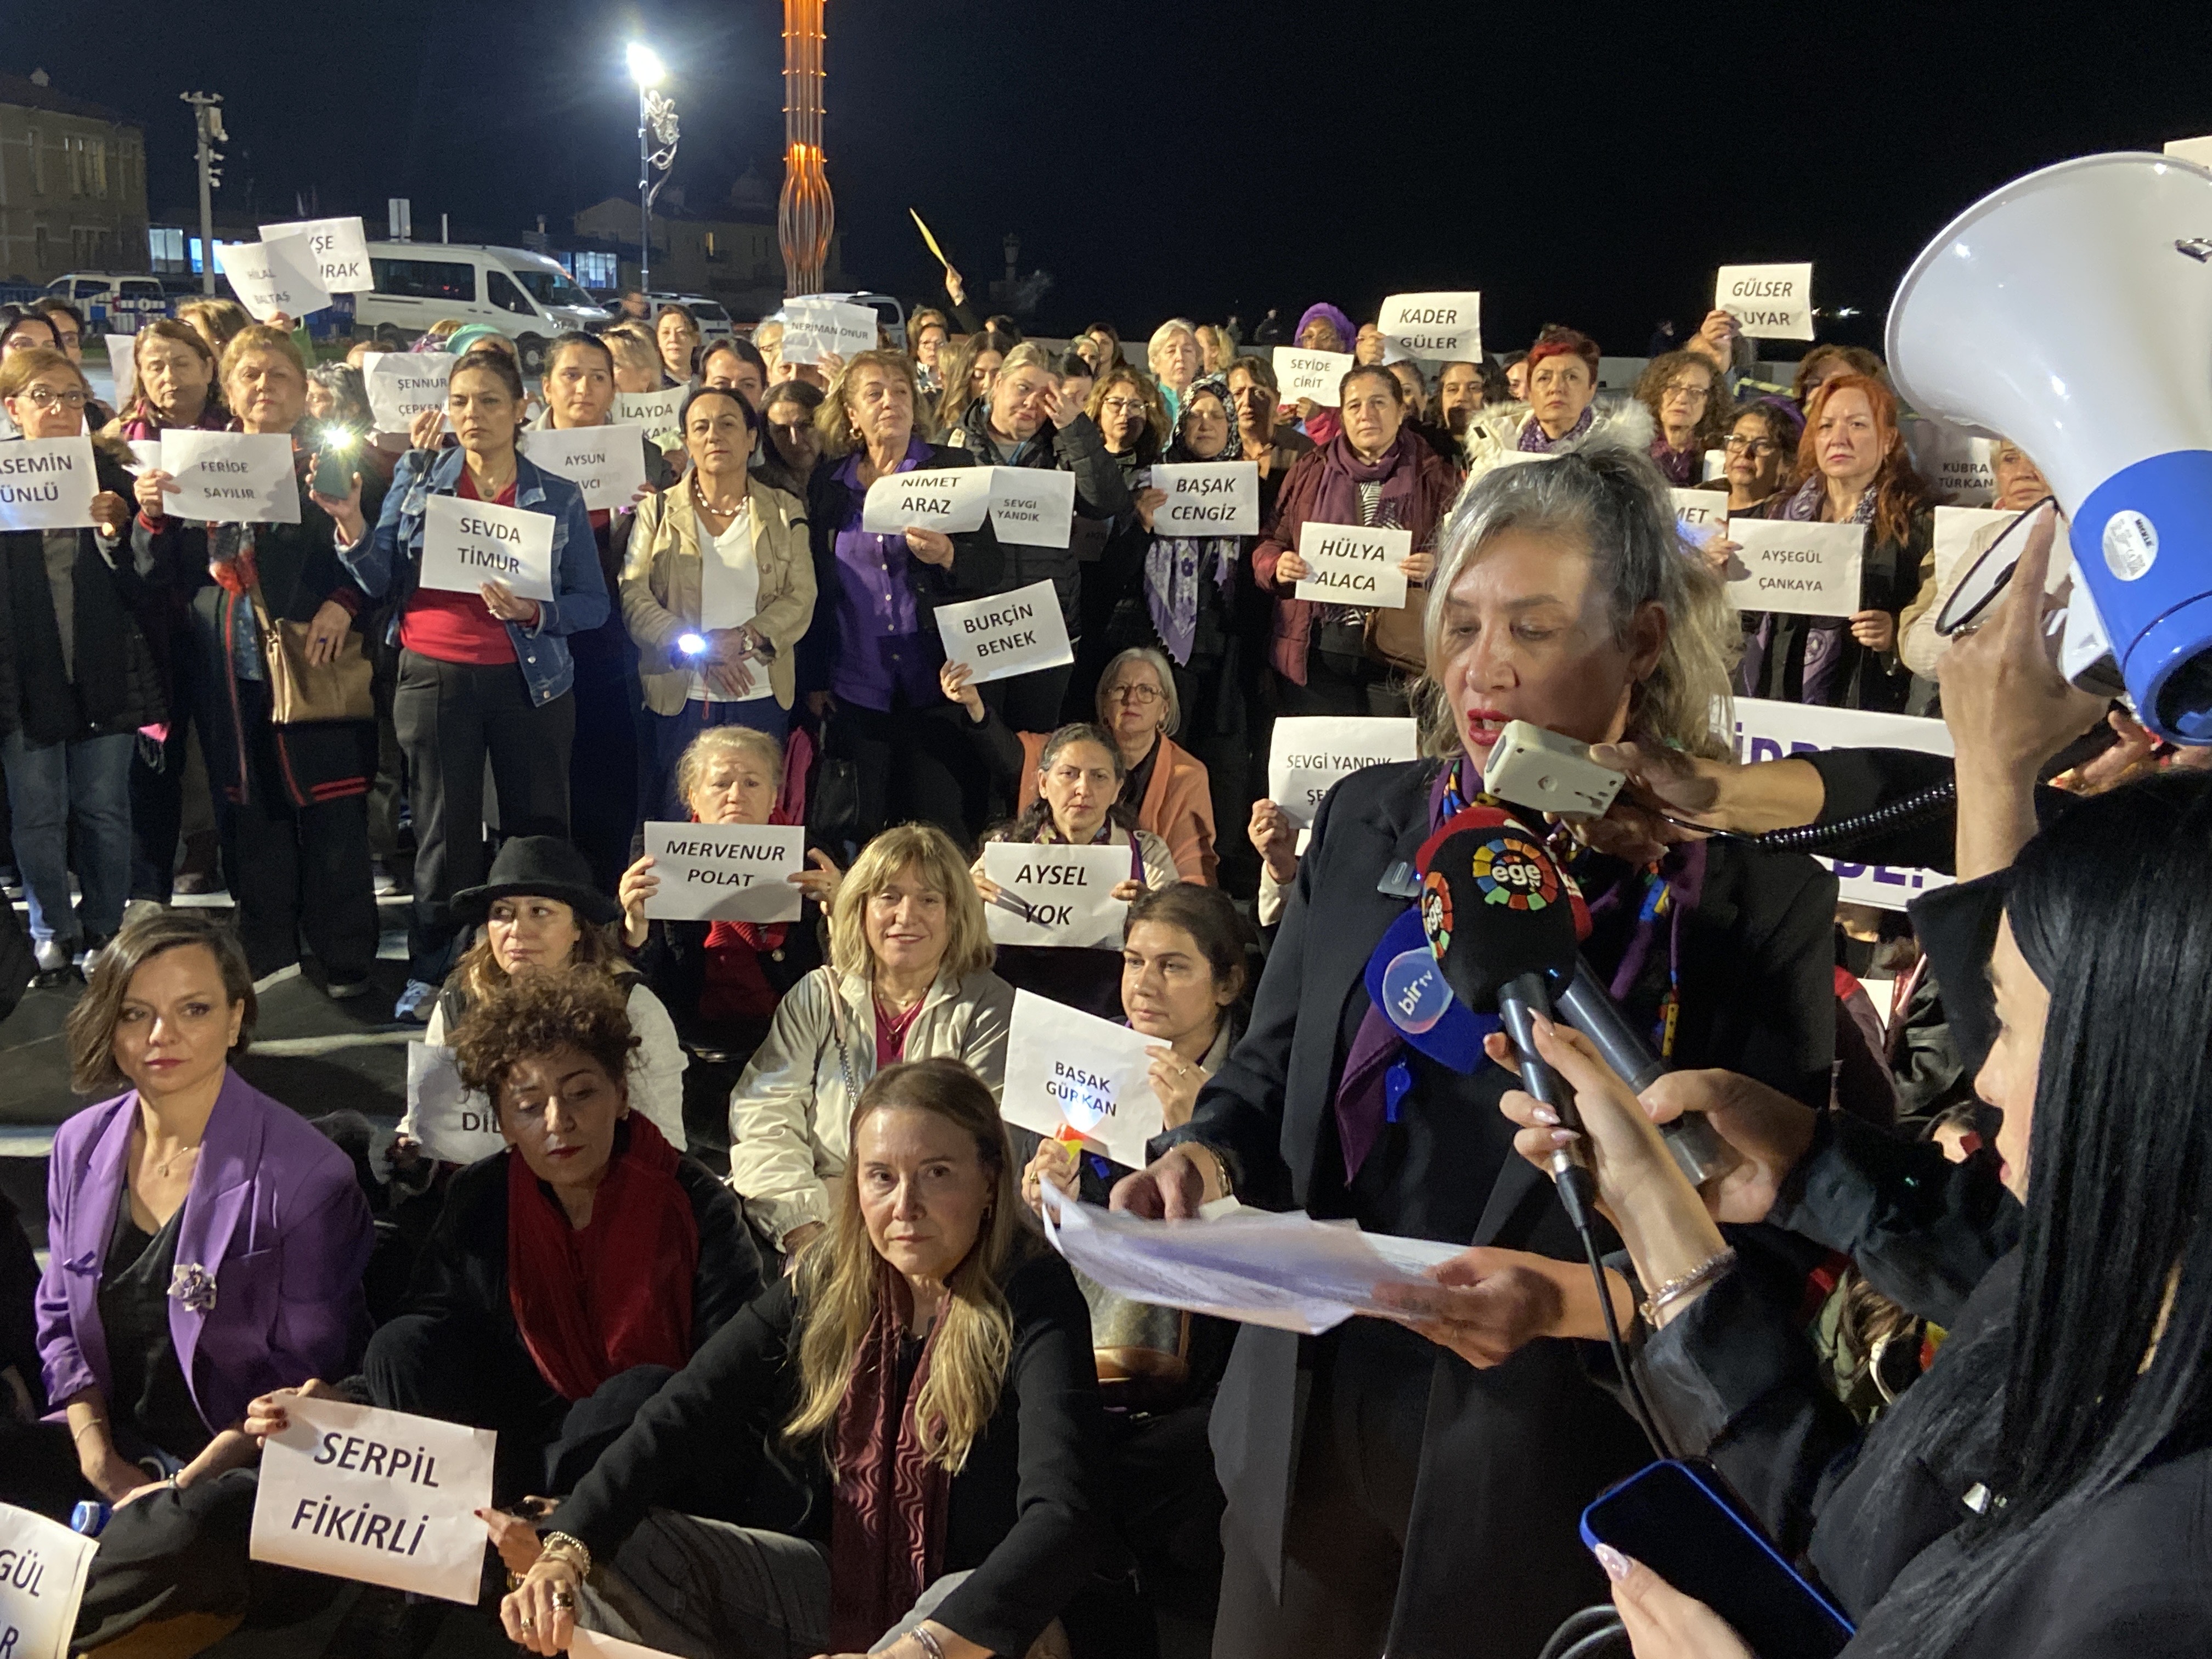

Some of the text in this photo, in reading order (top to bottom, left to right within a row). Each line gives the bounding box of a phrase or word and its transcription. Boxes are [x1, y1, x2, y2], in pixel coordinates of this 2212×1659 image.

[1732, 278, 1792, 297] GÜLSER
[1399, 308, 1457, 325] KADER
[1744, 312, 1790, 326] UYAR
[792, 321, 868, 340] NERİMAN ONUR
[1400, 334, 1457, 349] GÜLER
[1290, 357, 1331, 372] SEYİDE
[397, 378, 447, 391] ŞENNUR
[621, 403, 674, 418] İLAYDA
[0, 452, 72, 475] SEMİN
[200, 459, 249, 473] FERİDE
[565, 453, 606, 466] AYSUN
[1943, 461, 1989, 473] KÜBRA
[574, 479, 601, 490] VCI
[901, 475, 961, 488] NİMET
[1176, 477, 1237, 496] BAŞAK
[1938, 476, 1994, 488] TÜRKAN
[0, 482, 59, 503] ÜNLÜ
[204, 486, 255, 500] SAYILIR
[901, 496, 951, 515] ARAZ
[1171, 503, 1237, 522] CENGİZ
[997, 510, 1040, 523] YANDIK
[460, 517, 522, 544] SEVDA
[1319, 538, 1385, 561] HÜLYA
[1761, 548, 1823, 566] AYŞEGÜL
[457, 545, 520, 574] TİMUR
[1315, 571, 1376, 592] ALACA
[1759, 576, 1823, 592] ÇANKAYA
[963, 603, 1034, 634] BURÇİN
[977, 630, 1036, 657] BENEK
[1286, 753, 1328, 769] SEVGİ
[665, 839, 786, 862] MERVENUR
[686, 868, 754, 887] POLAT
[1015, 864, 1088, 887] AYSEL
[1491, 864, 1542, 885] ege
[1024, 902, 1073, 926] YOK
[1398, 979, 1422, 1015] bir
[1055, 1060, 1110, 1093] BAŞAK
[1046, 1081, 1117, 1117] GÜRKAN
[314, 1431, 441, 1488] SERPİL
[291, 1496, 429, 1556] FİKİRLİ
